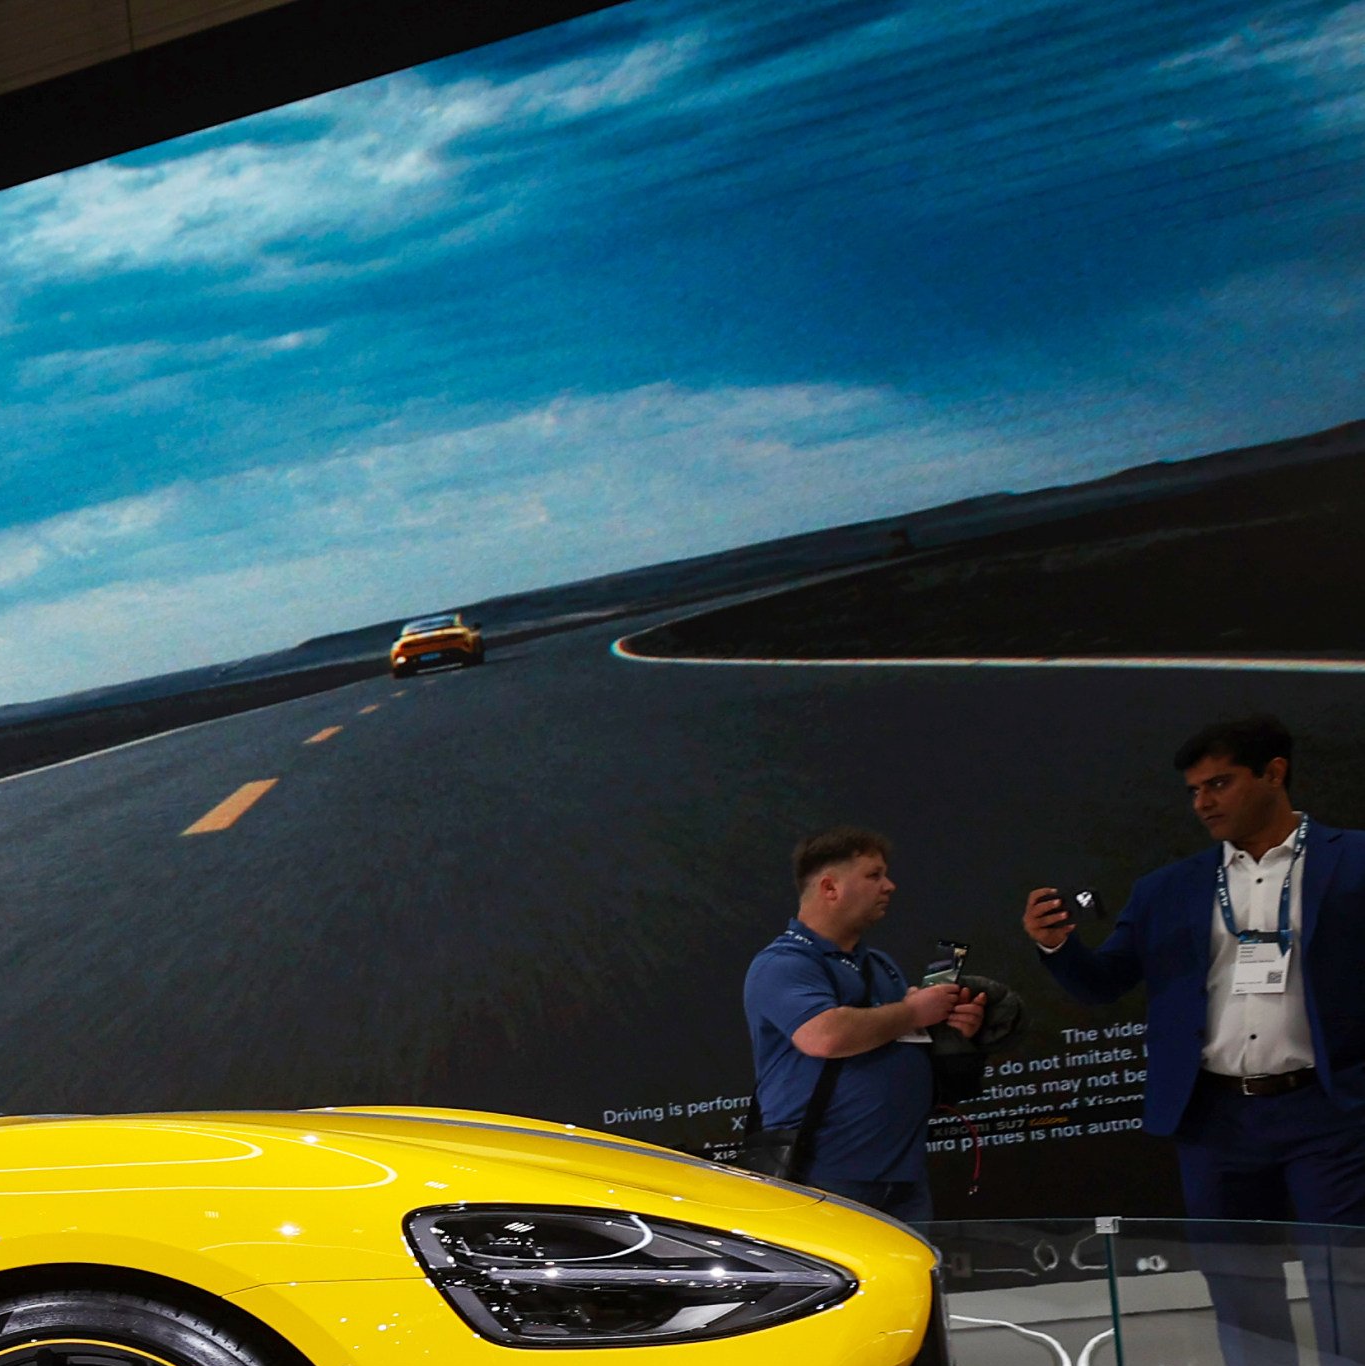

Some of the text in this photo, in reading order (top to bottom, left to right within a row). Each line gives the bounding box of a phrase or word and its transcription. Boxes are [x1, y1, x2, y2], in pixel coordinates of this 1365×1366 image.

[1062, 1022, 1148, 1044] The vide
[603, 1106, 664, 1125] Driving
[669, 1102, 683, 1116] is
[687, 1095, 753, 1118] perform
[999, 1060, 1024, 1076] do
[1029, 1055, 1061, 1072] not
[1066, 1046, 1138, 1067] imitate.
[1042, 1078, 1081, 1096] may
[1086, 1071, 1119, 1088] not
[1124, 1067, 1148, 1083] be
[1050, 1123, 1084, 1140] not
